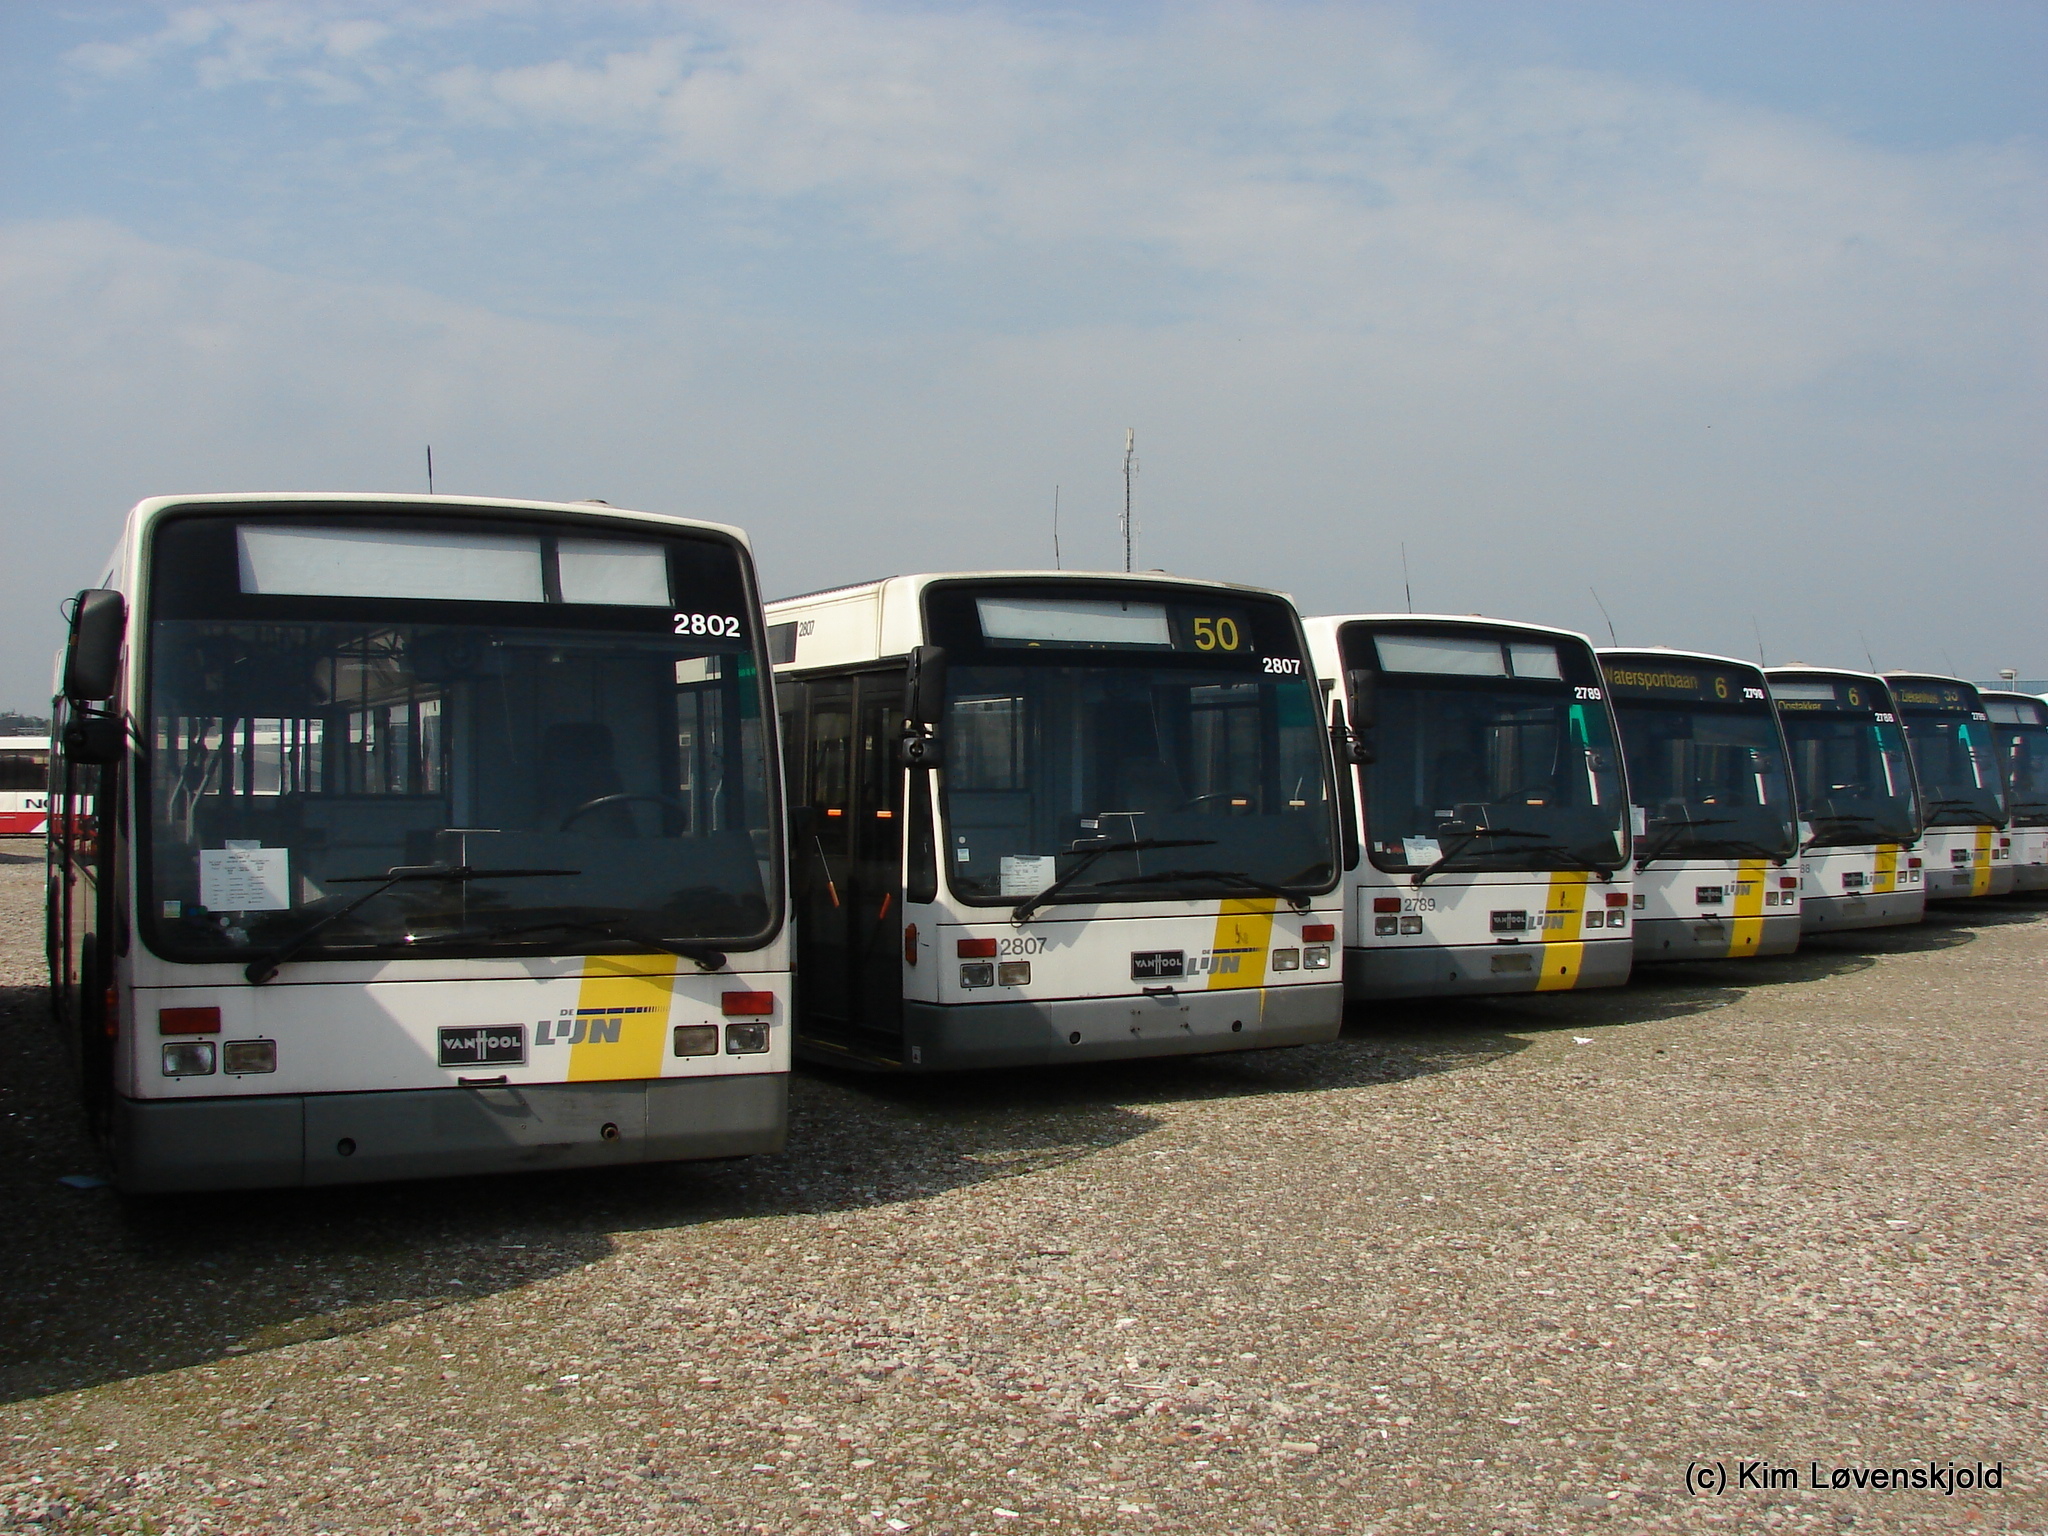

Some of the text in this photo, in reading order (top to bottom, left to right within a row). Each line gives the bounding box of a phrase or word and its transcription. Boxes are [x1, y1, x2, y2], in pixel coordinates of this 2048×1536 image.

[673, 613, 741, 638] 2802
[798, 620, 815, 637] 2807
[1194, 617, 1239, 651] 50
[1262, 657, 1300, 675] 2807
[1574, 686, 1601, 700] 2789
[1714, 677, 1727, 699] 6
[1847, 687, 1860, 706] 6
[1404, 897, 1436, 912] 2789
[1000, 937, 1047, 956] 2807
[1186, 955, 1241, 976] LIJN
[559, 1008, 574, 1017] DE
[534, 1018, 623, 1046] LIJN
